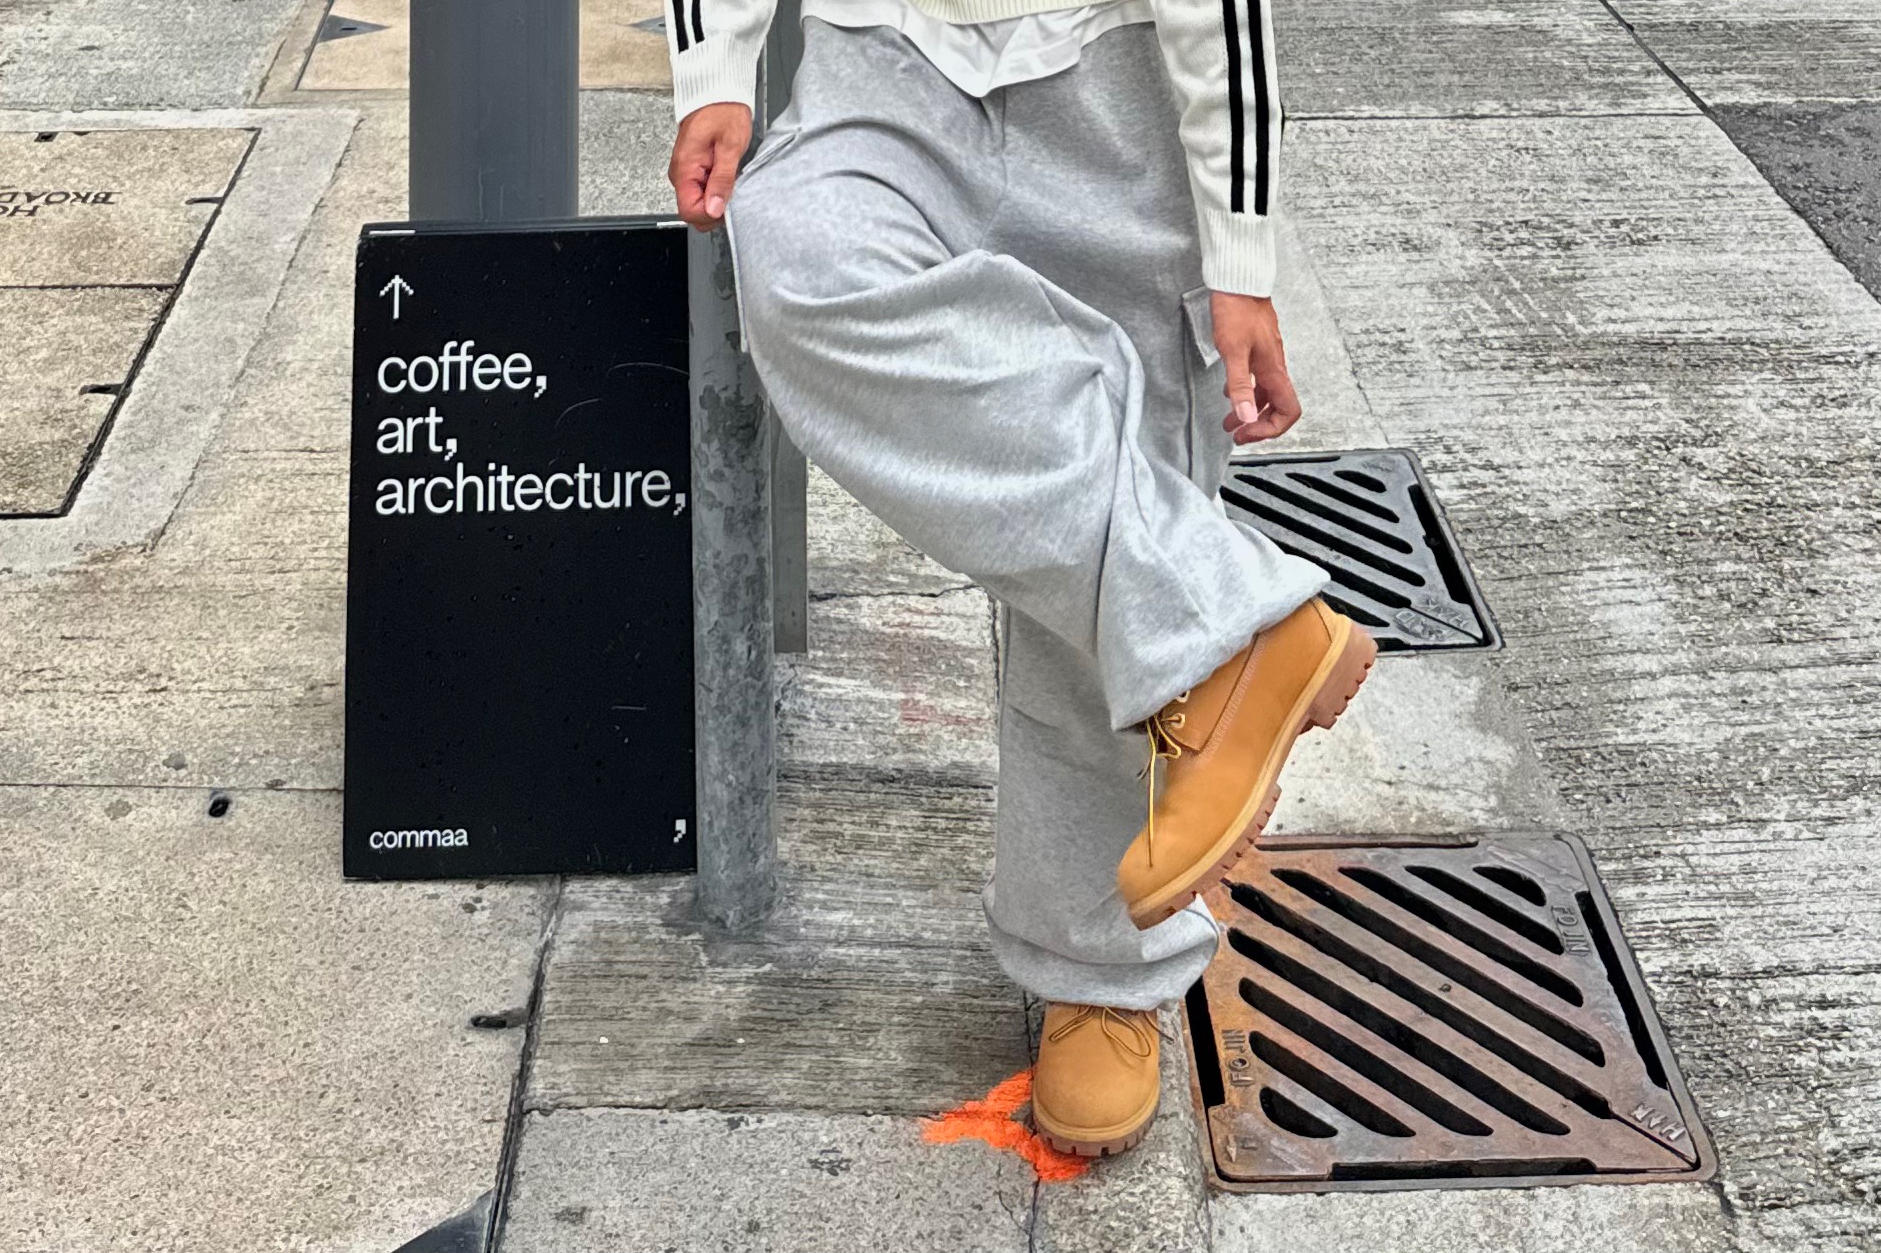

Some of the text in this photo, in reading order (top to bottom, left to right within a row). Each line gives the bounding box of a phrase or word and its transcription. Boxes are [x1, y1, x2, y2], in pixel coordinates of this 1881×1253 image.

[377, 340, 547, 399] coffee,
[376, 406, 457, 461] art,
[375, 462, 686, 516] architecture,
[369, 828, 469, 849] commaa
